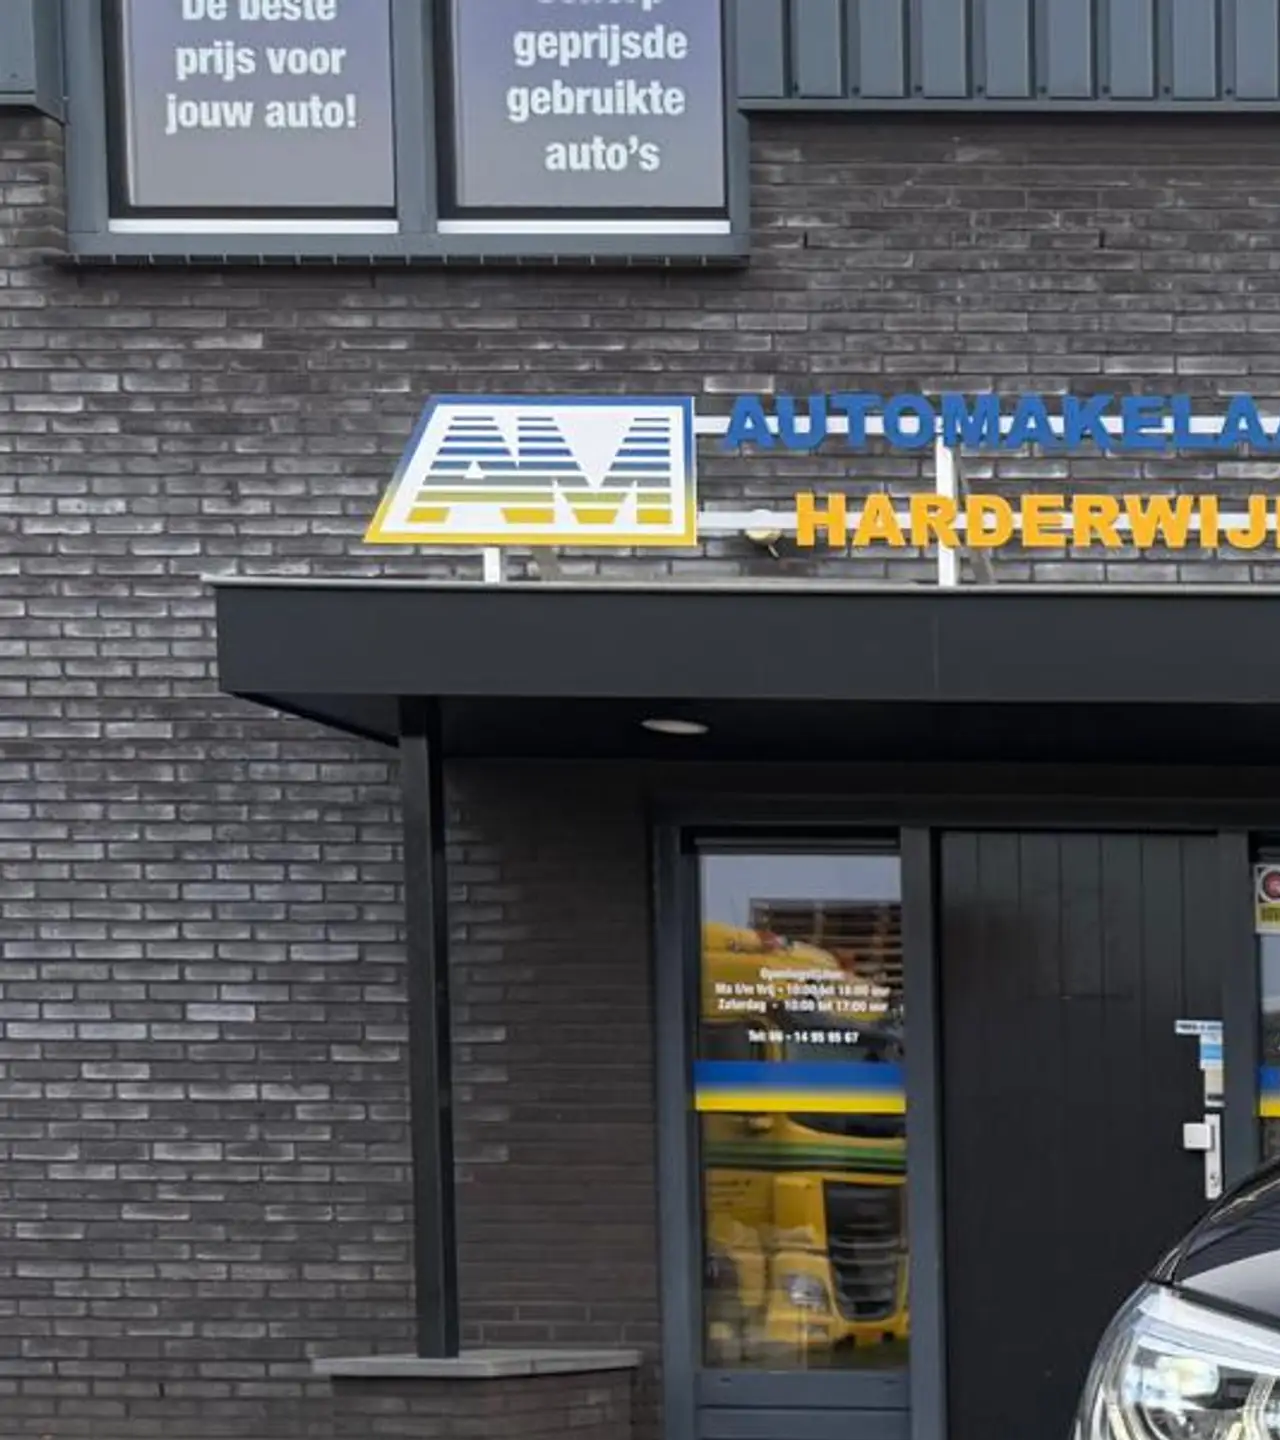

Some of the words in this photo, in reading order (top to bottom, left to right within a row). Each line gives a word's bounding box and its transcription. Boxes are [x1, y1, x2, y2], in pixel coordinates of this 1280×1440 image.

[239, 0, 338, 21] beste
[175, 41, 255, 81] prijs
[266, 48, 347, 75] voor
[513, 24, 688, 68] geprijsde
[165, 94, 254, 135] jouw
[264, 94, 358, 129] auto!
[506, 79, 686, 123] gebruikte
[545, 135, 661, 172] auto's
